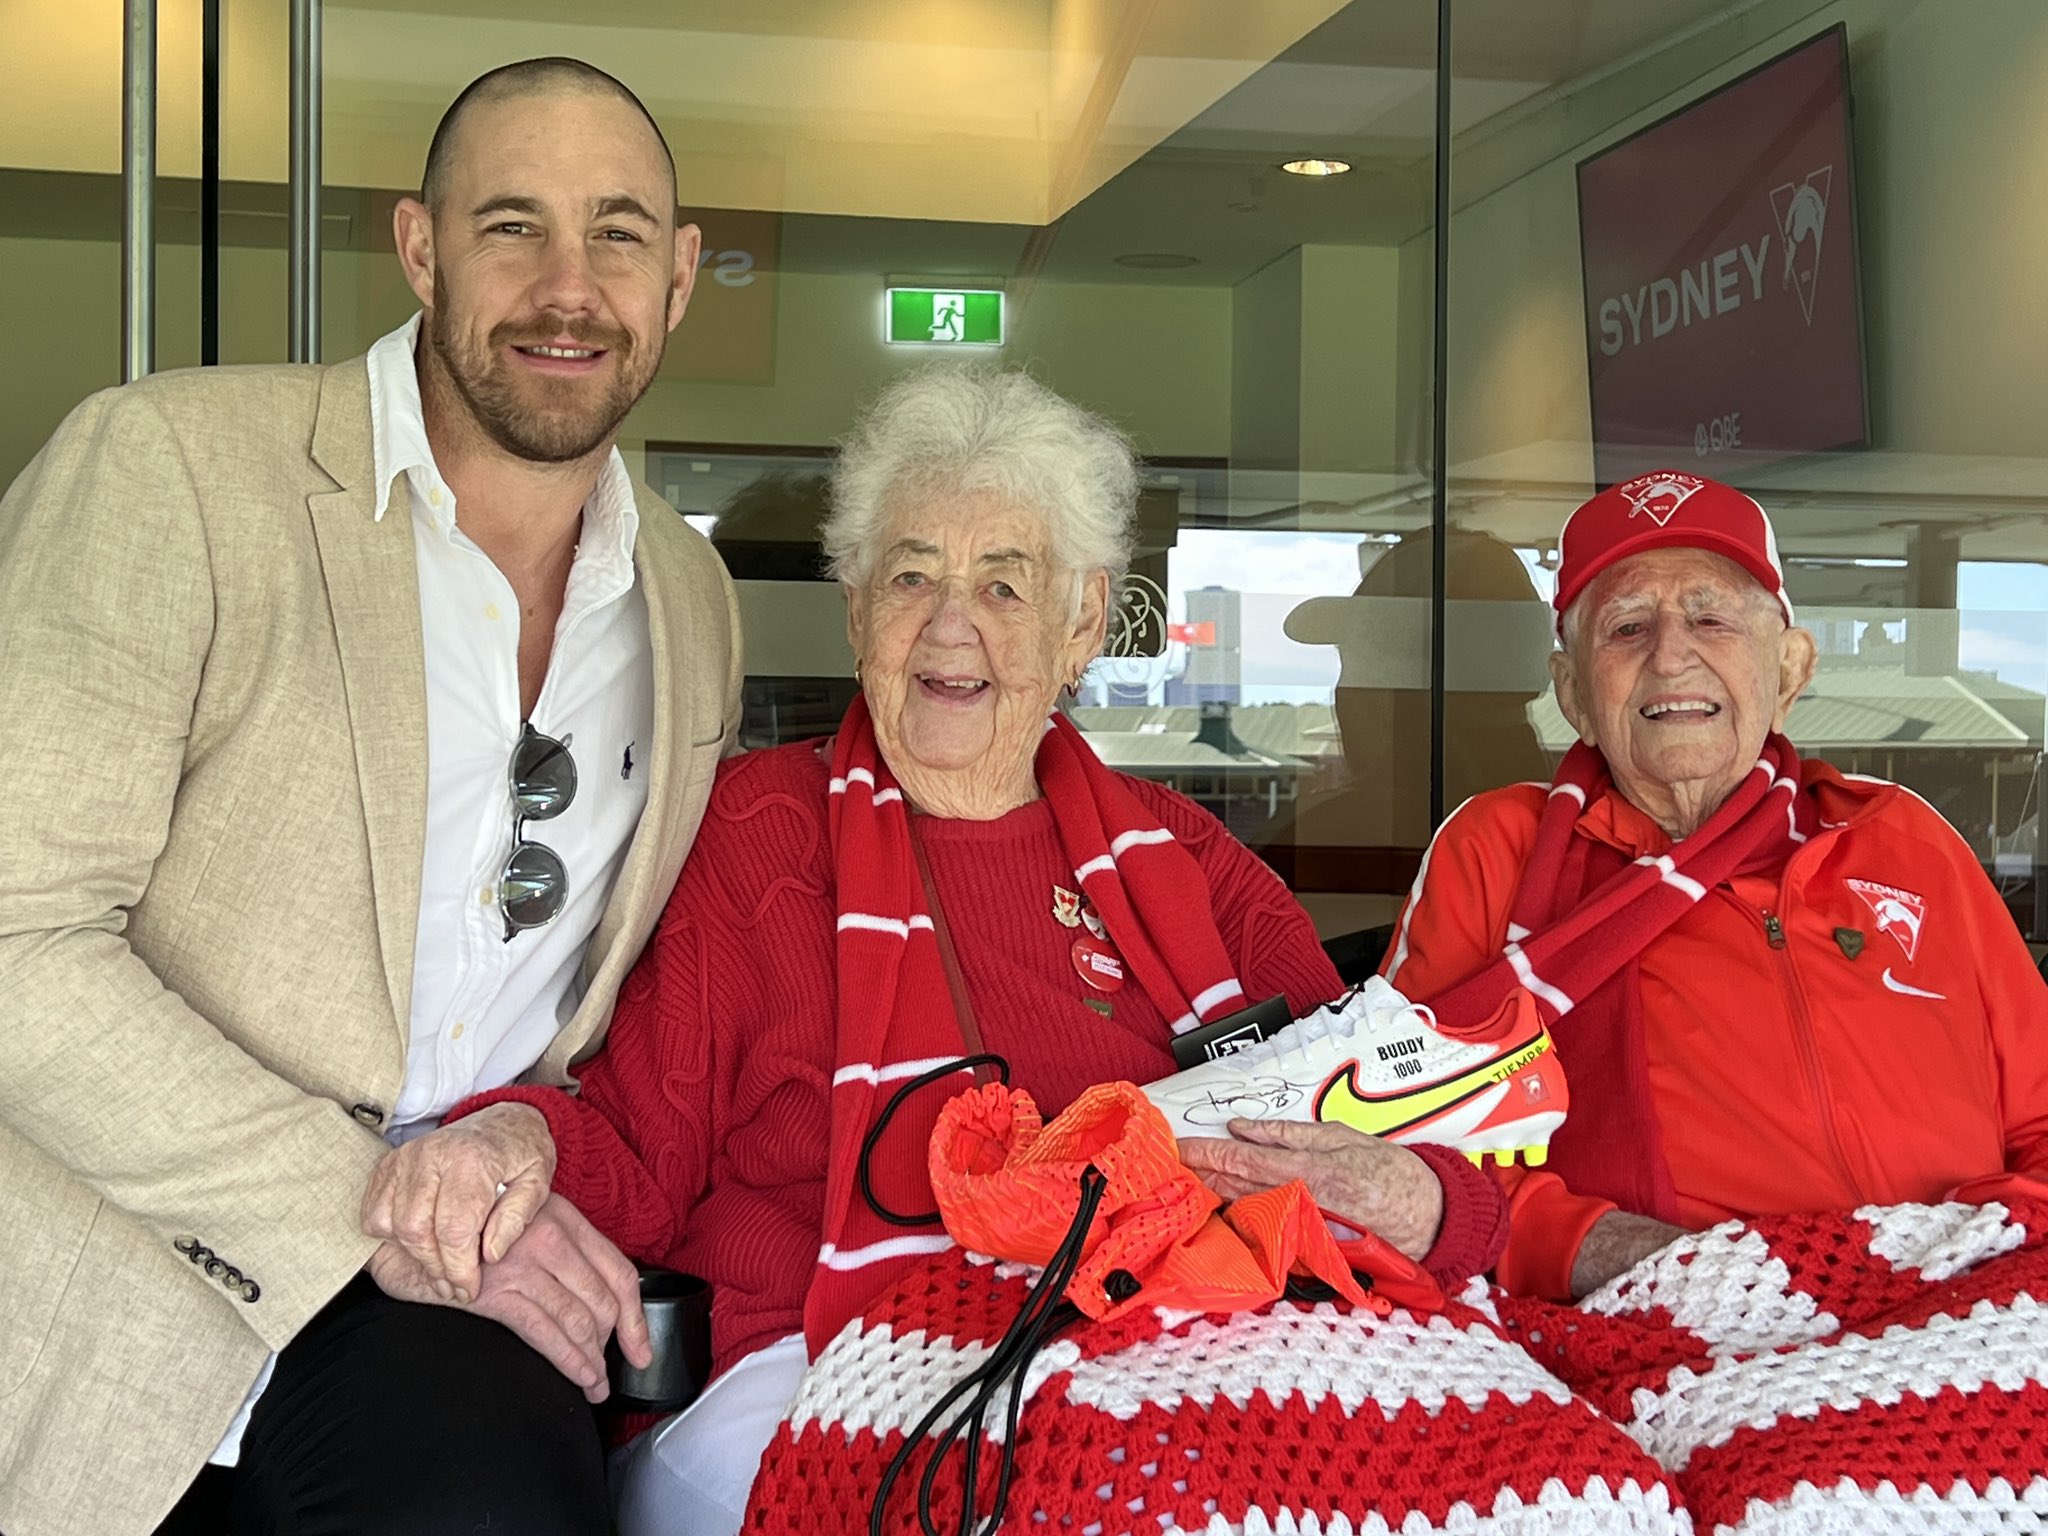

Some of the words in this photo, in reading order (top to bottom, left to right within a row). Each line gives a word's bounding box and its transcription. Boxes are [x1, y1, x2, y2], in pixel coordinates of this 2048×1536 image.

[1600, 235, 1770, 356] SYDNEY
[1710, 412, 1741, 451] QBE
[1846, 879, 1922, 906] SYDNEY
[1376, 1036, 1425, 1061] BUDDY
[1393, 1059, 1423, 1079] 1000
